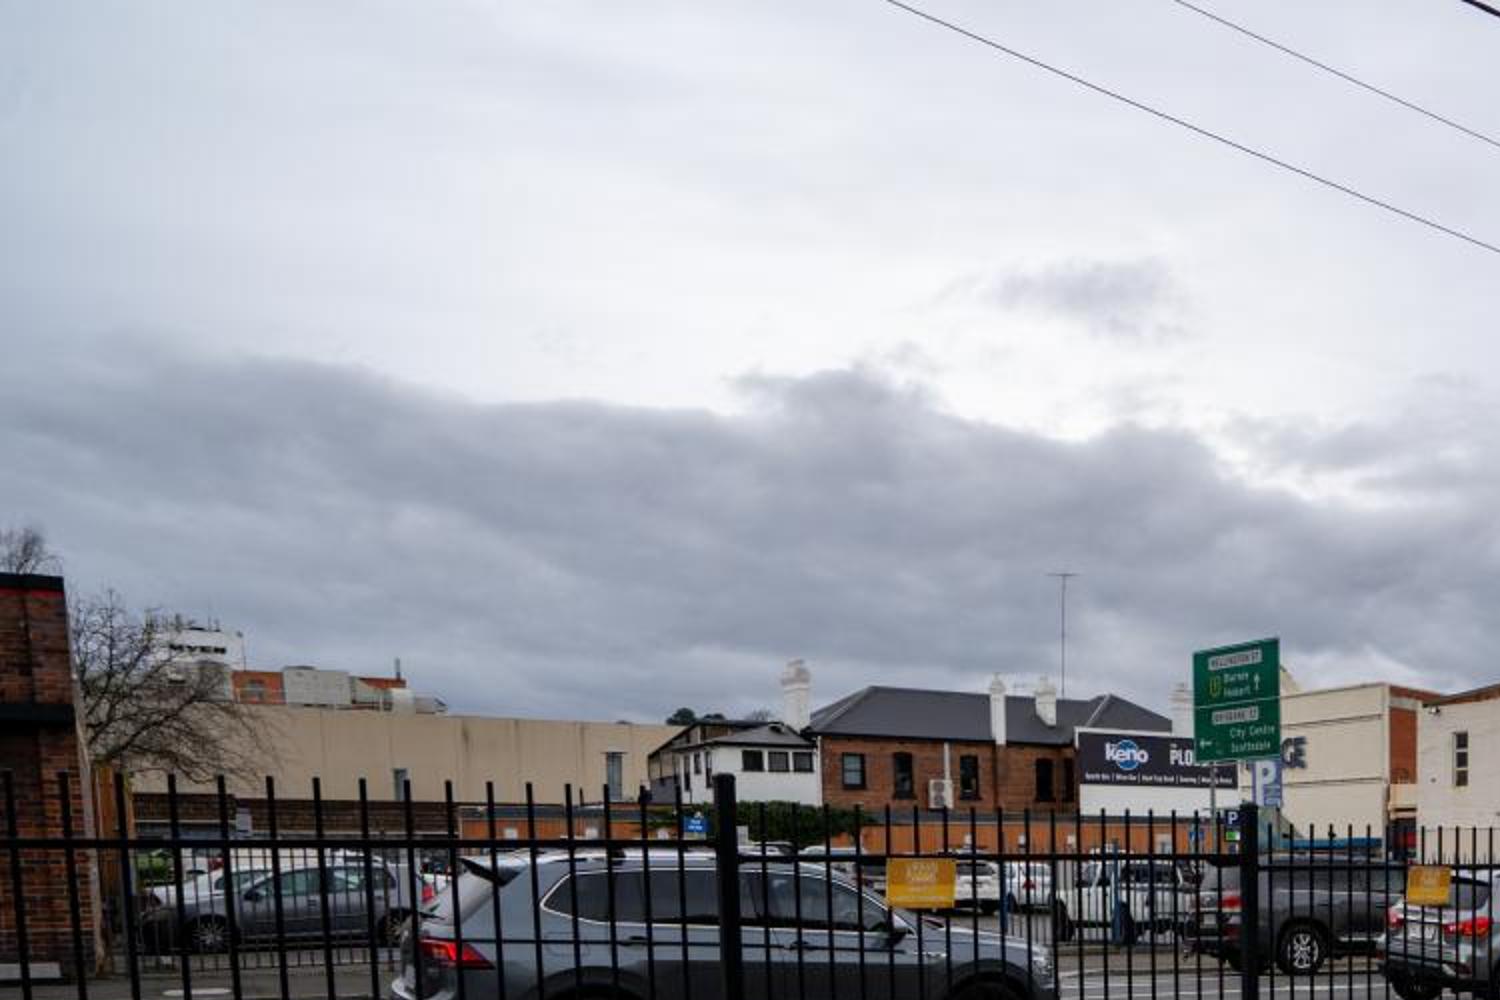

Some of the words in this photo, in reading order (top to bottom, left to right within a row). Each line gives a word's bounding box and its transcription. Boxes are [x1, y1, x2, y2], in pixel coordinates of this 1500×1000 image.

[169, 644, 226, 654] MYER
[1229, 727, 1246, 739] City
[1249, 725, 1276, 736] Centre
[1228, 811, 1238, 825] P
